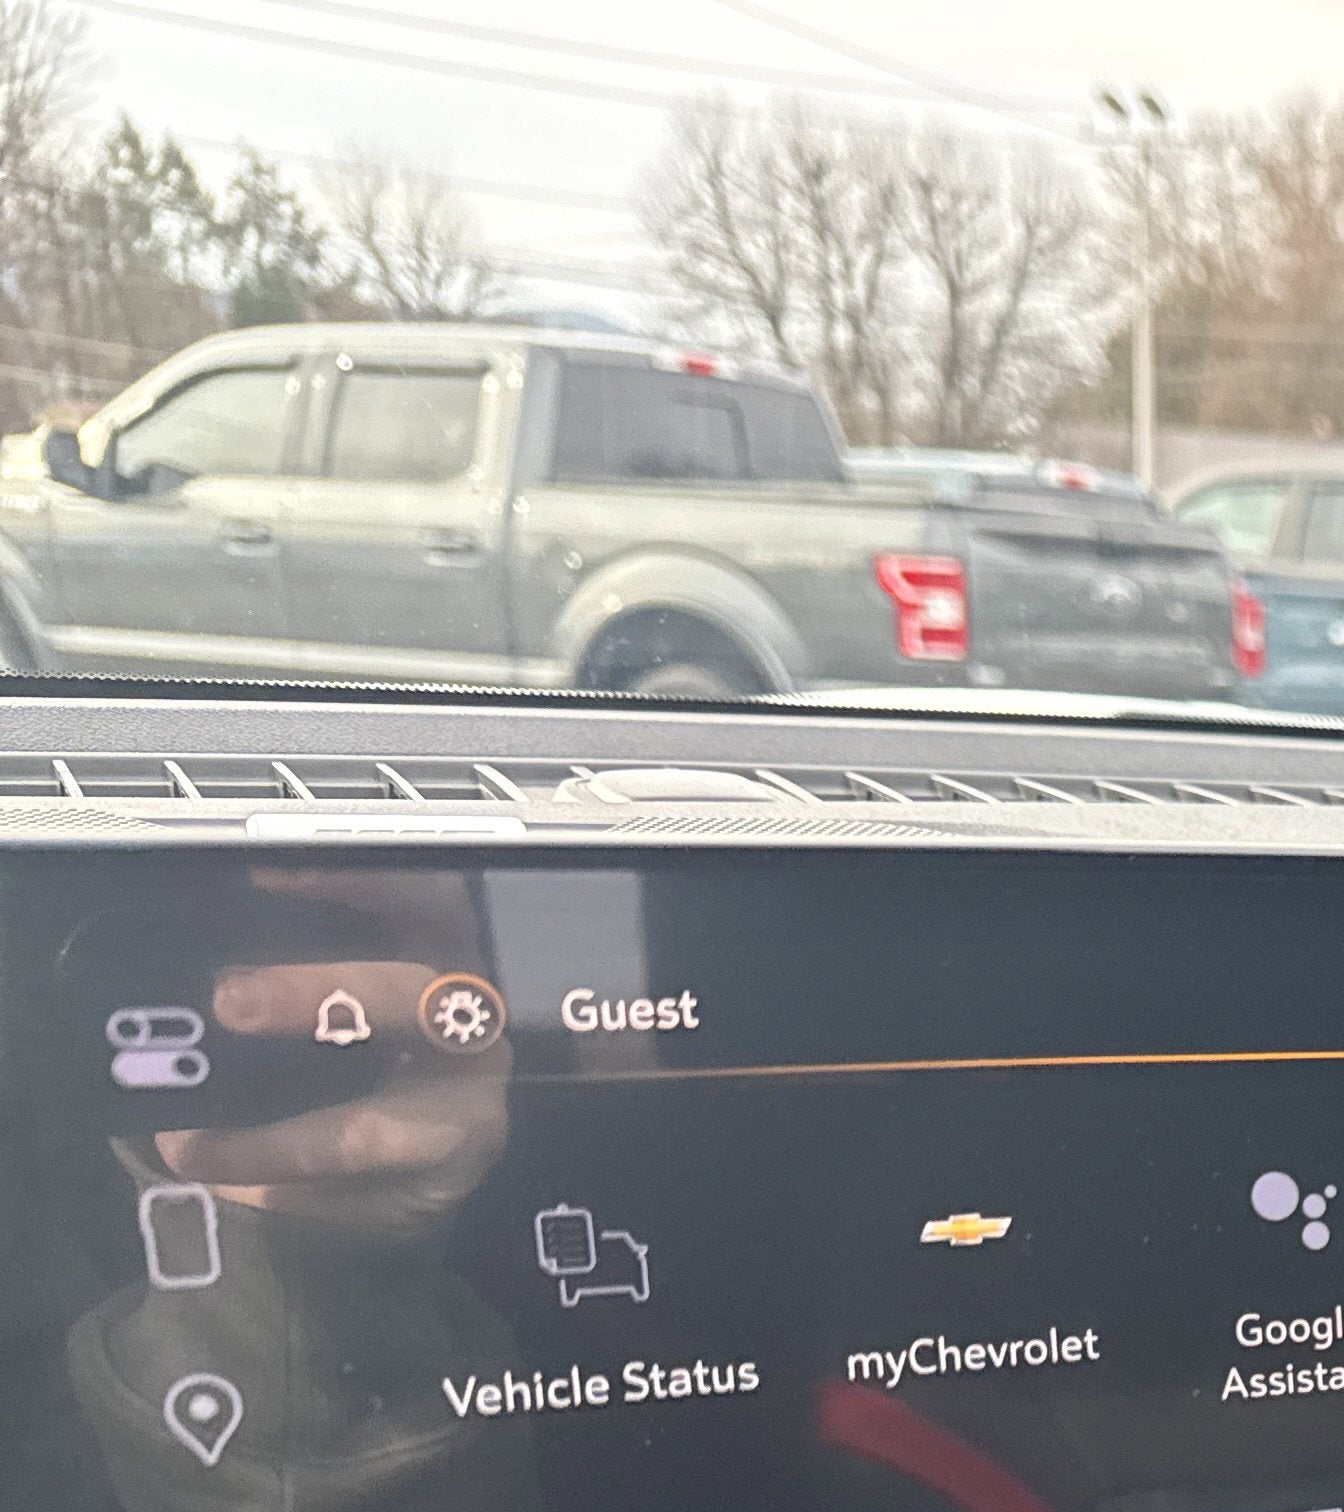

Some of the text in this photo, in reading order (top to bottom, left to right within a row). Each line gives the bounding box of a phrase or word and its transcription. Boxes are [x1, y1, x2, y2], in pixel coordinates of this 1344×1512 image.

[560, 988, 700, 1032] Guest
[847, 1325, 1101, 1385] myChevrolet
[442, 1357, 761, 1418] Vehicle Status
